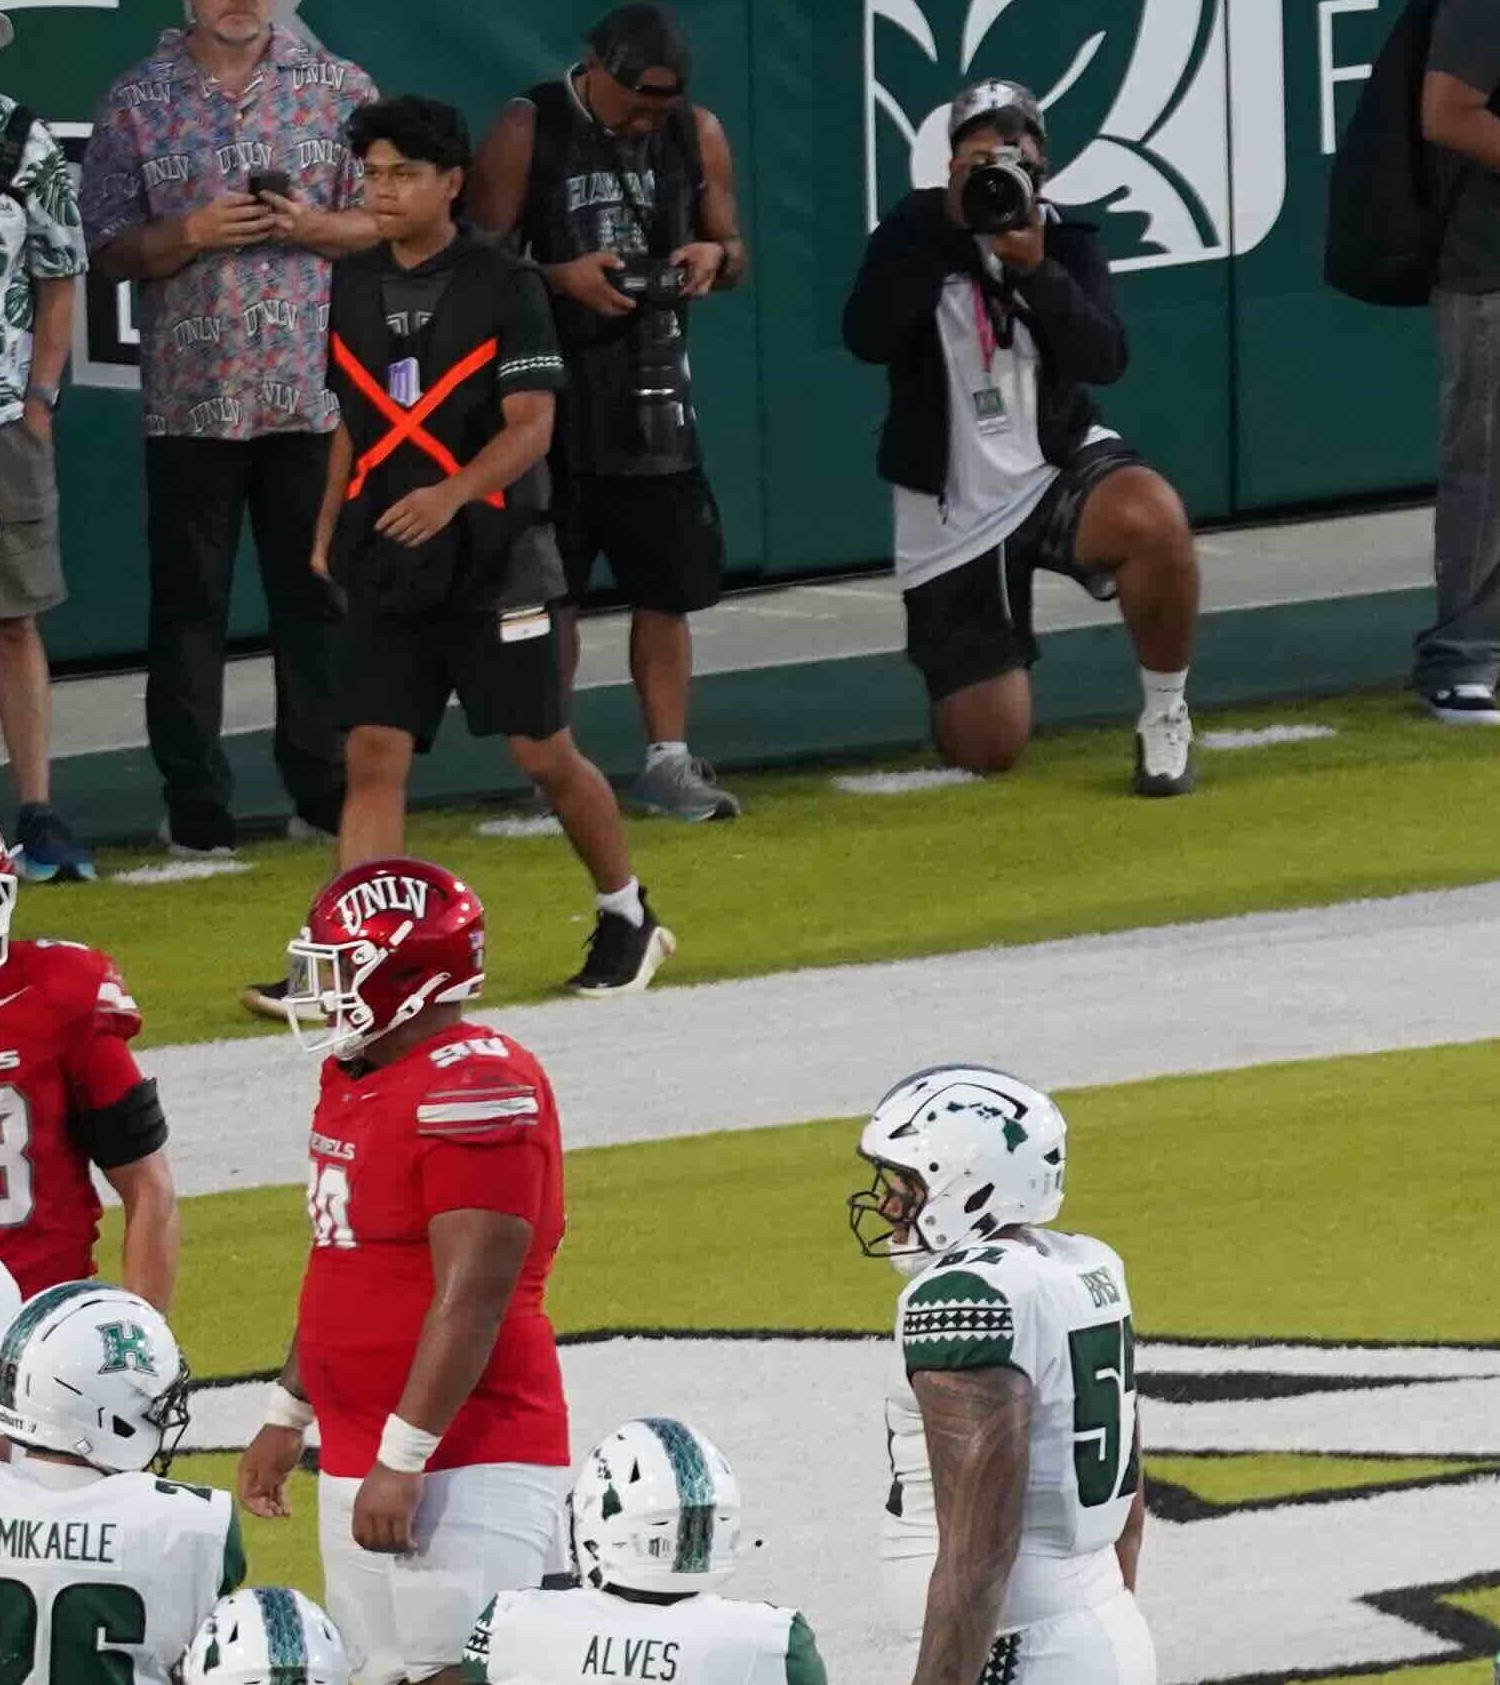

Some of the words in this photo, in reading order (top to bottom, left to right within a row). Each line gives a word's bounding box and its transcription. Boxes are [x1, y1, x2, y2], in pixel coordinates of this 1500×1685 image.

[216, 141, 273, 174] UNLV
[244, 301, 298, 336] UNLV
[336, 876, 429, 936] UNLV
[95, 1319, 159, 1376] H
[581, 1634, 681, 1682] ALVES
